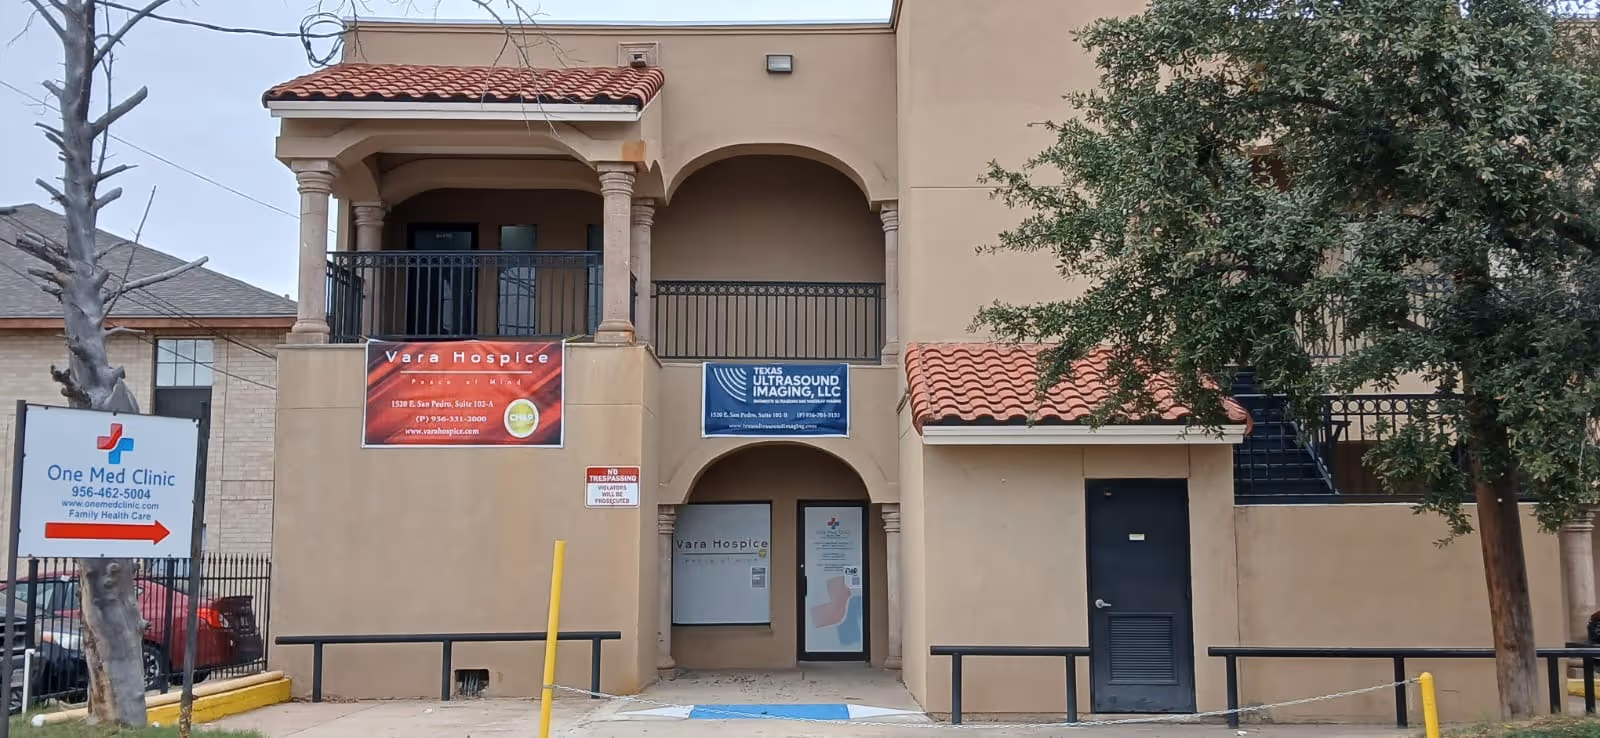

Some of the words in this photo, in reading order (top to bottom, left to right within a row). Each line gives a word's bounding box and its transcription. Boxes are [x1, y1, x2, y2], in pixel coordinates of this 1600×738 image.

[385, 350, 440, 363] Vara
[453, 350, 549, 367] Hospice
[753, 367, 782, 375] TEXAS
[490, 378, 522, 386] Mind
[753, 376, 840, 386] ULTRASOUND
[753, 386, 814, 399] IMAGING,
[818, 386, 841, 397] LLC
[431, 400, 454, 409] Pedro,
[454, 400, 472, 408] Suite
[416, 415, 430, 424] (P)
[405, 428, 480, 438] www.varahospice.com
[48, 464, 83, 482] One
[90, 467, 125, 484] Med
[132, 469, 176, 486] Clinic
[72, 486, 151, 500] 956-462-5004
[62, 500, 159, 510] www.onemedclinic.com
[68, 509, 98, 520] Family
[101, 510, 129, 520] Health
[132, 511, 152, 520] Care
[676, 540, 707, 549] Vara
[712, 538, 768, 550] Hospice
